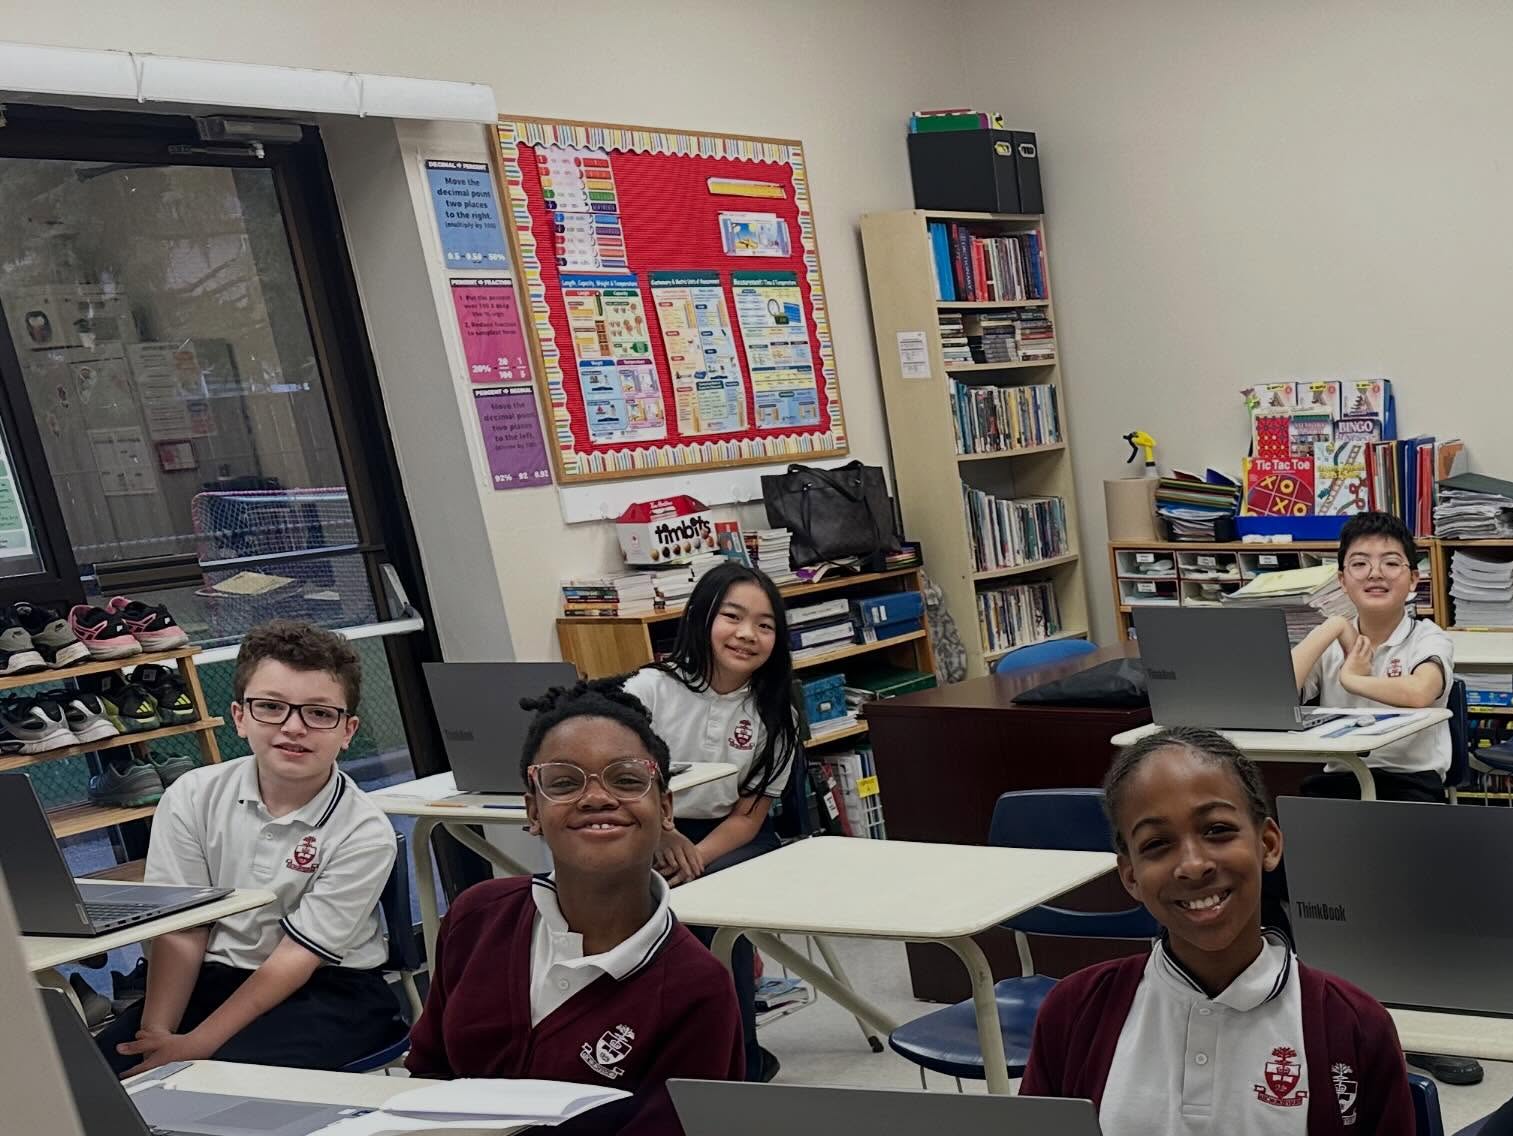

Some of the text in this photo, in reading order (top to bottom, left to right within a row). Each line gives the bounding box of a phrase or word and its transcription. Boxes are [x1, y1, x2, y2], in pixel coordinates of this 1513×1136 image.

[445, 177, 480, 186] Move the
[437, 188, 491, 199] decimal point
[464, 200, 489, 209] places
[456, 211, 469, 219] the
[1338, 421, 1374, 433] BINGO
[1256, 459, 1310, 471] Tic Tac Toe
[655, 516, 711, 544] timbits
[1296, 901, 1346, 922] ThinkBook
